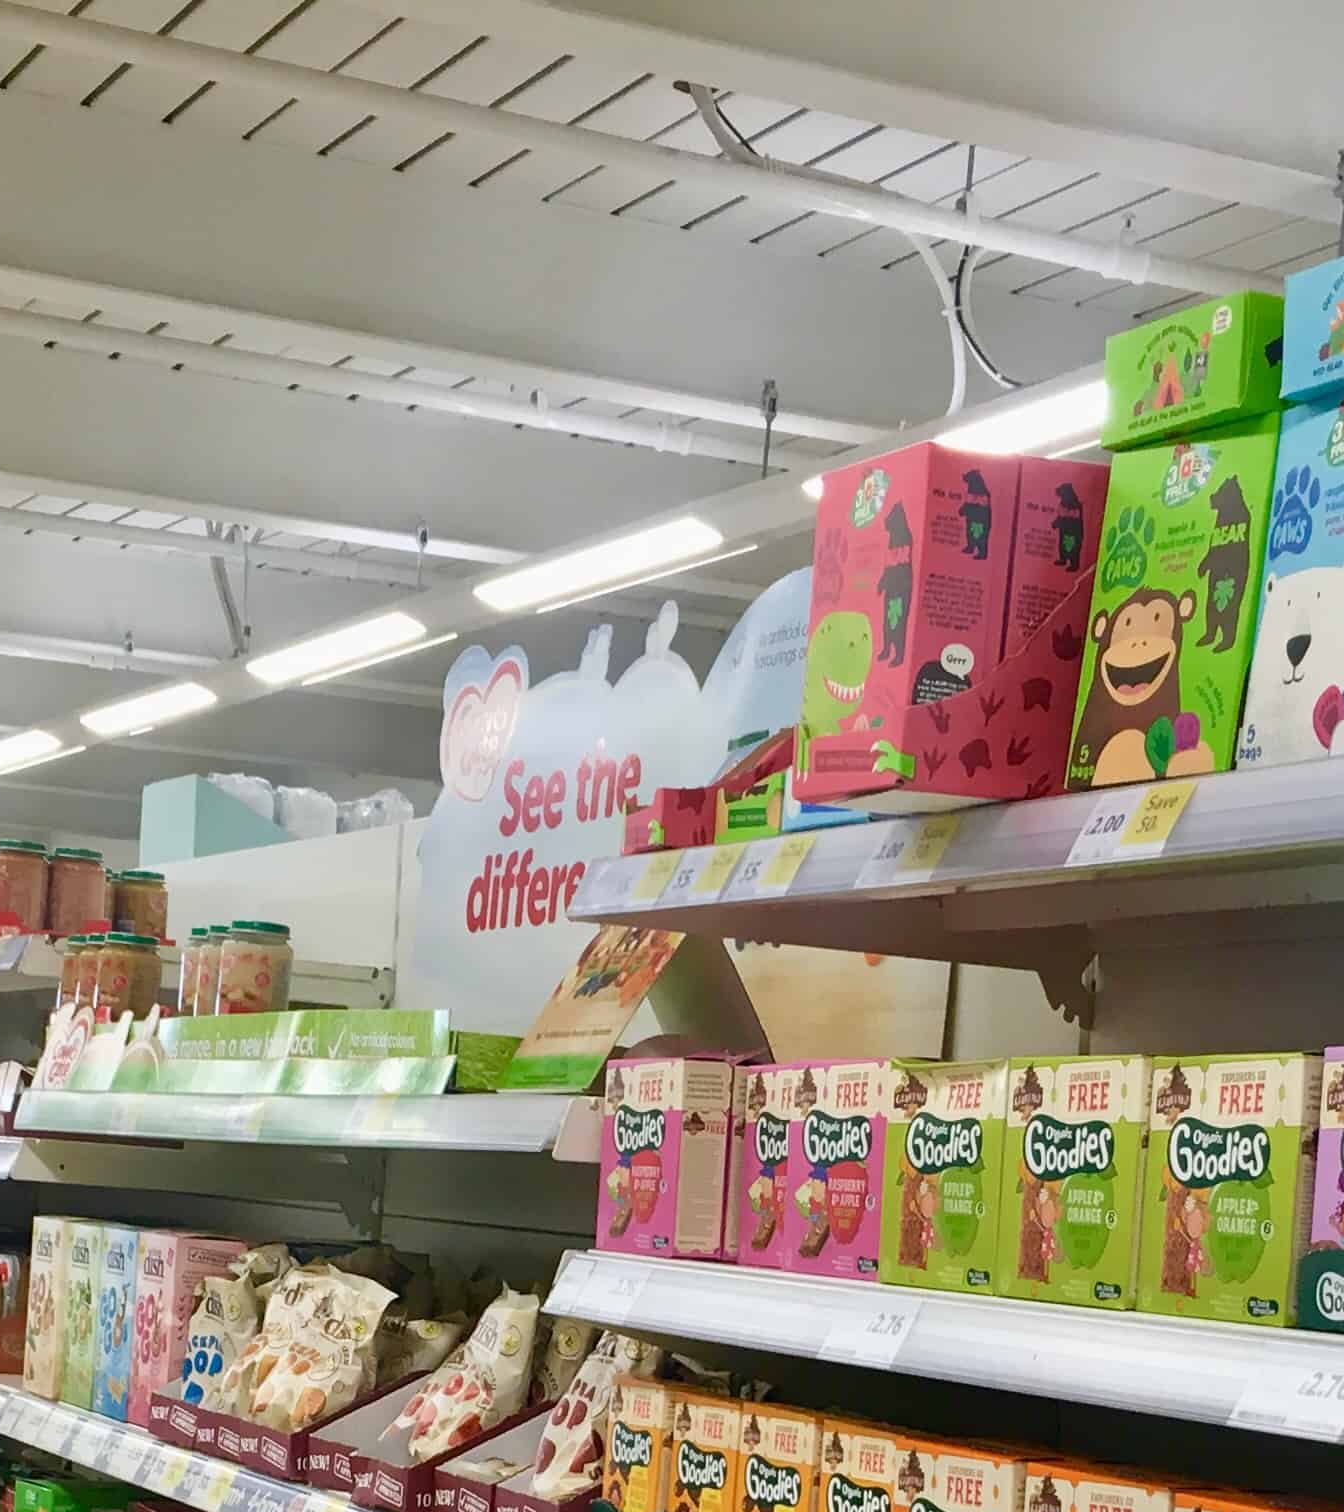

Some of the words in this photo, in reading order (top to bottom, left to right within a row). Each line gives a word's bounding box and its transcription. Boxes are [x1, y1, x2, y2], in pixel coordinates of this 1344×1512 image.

[1107, 555, 1141, 581] PAWS
[945, 653, 968, 666] Grrr
[1246, 724, 1256, 744] 5
[499, 759, 566, 837] See
[577, 738, 641, 822] the
[1145, 794, 1178, 812] Save
[1217, 1219, 1257, 1235] ORANGE
[416, 1493, 432, 1507] 10
[434, 1488, 455, 1508] NEW!
